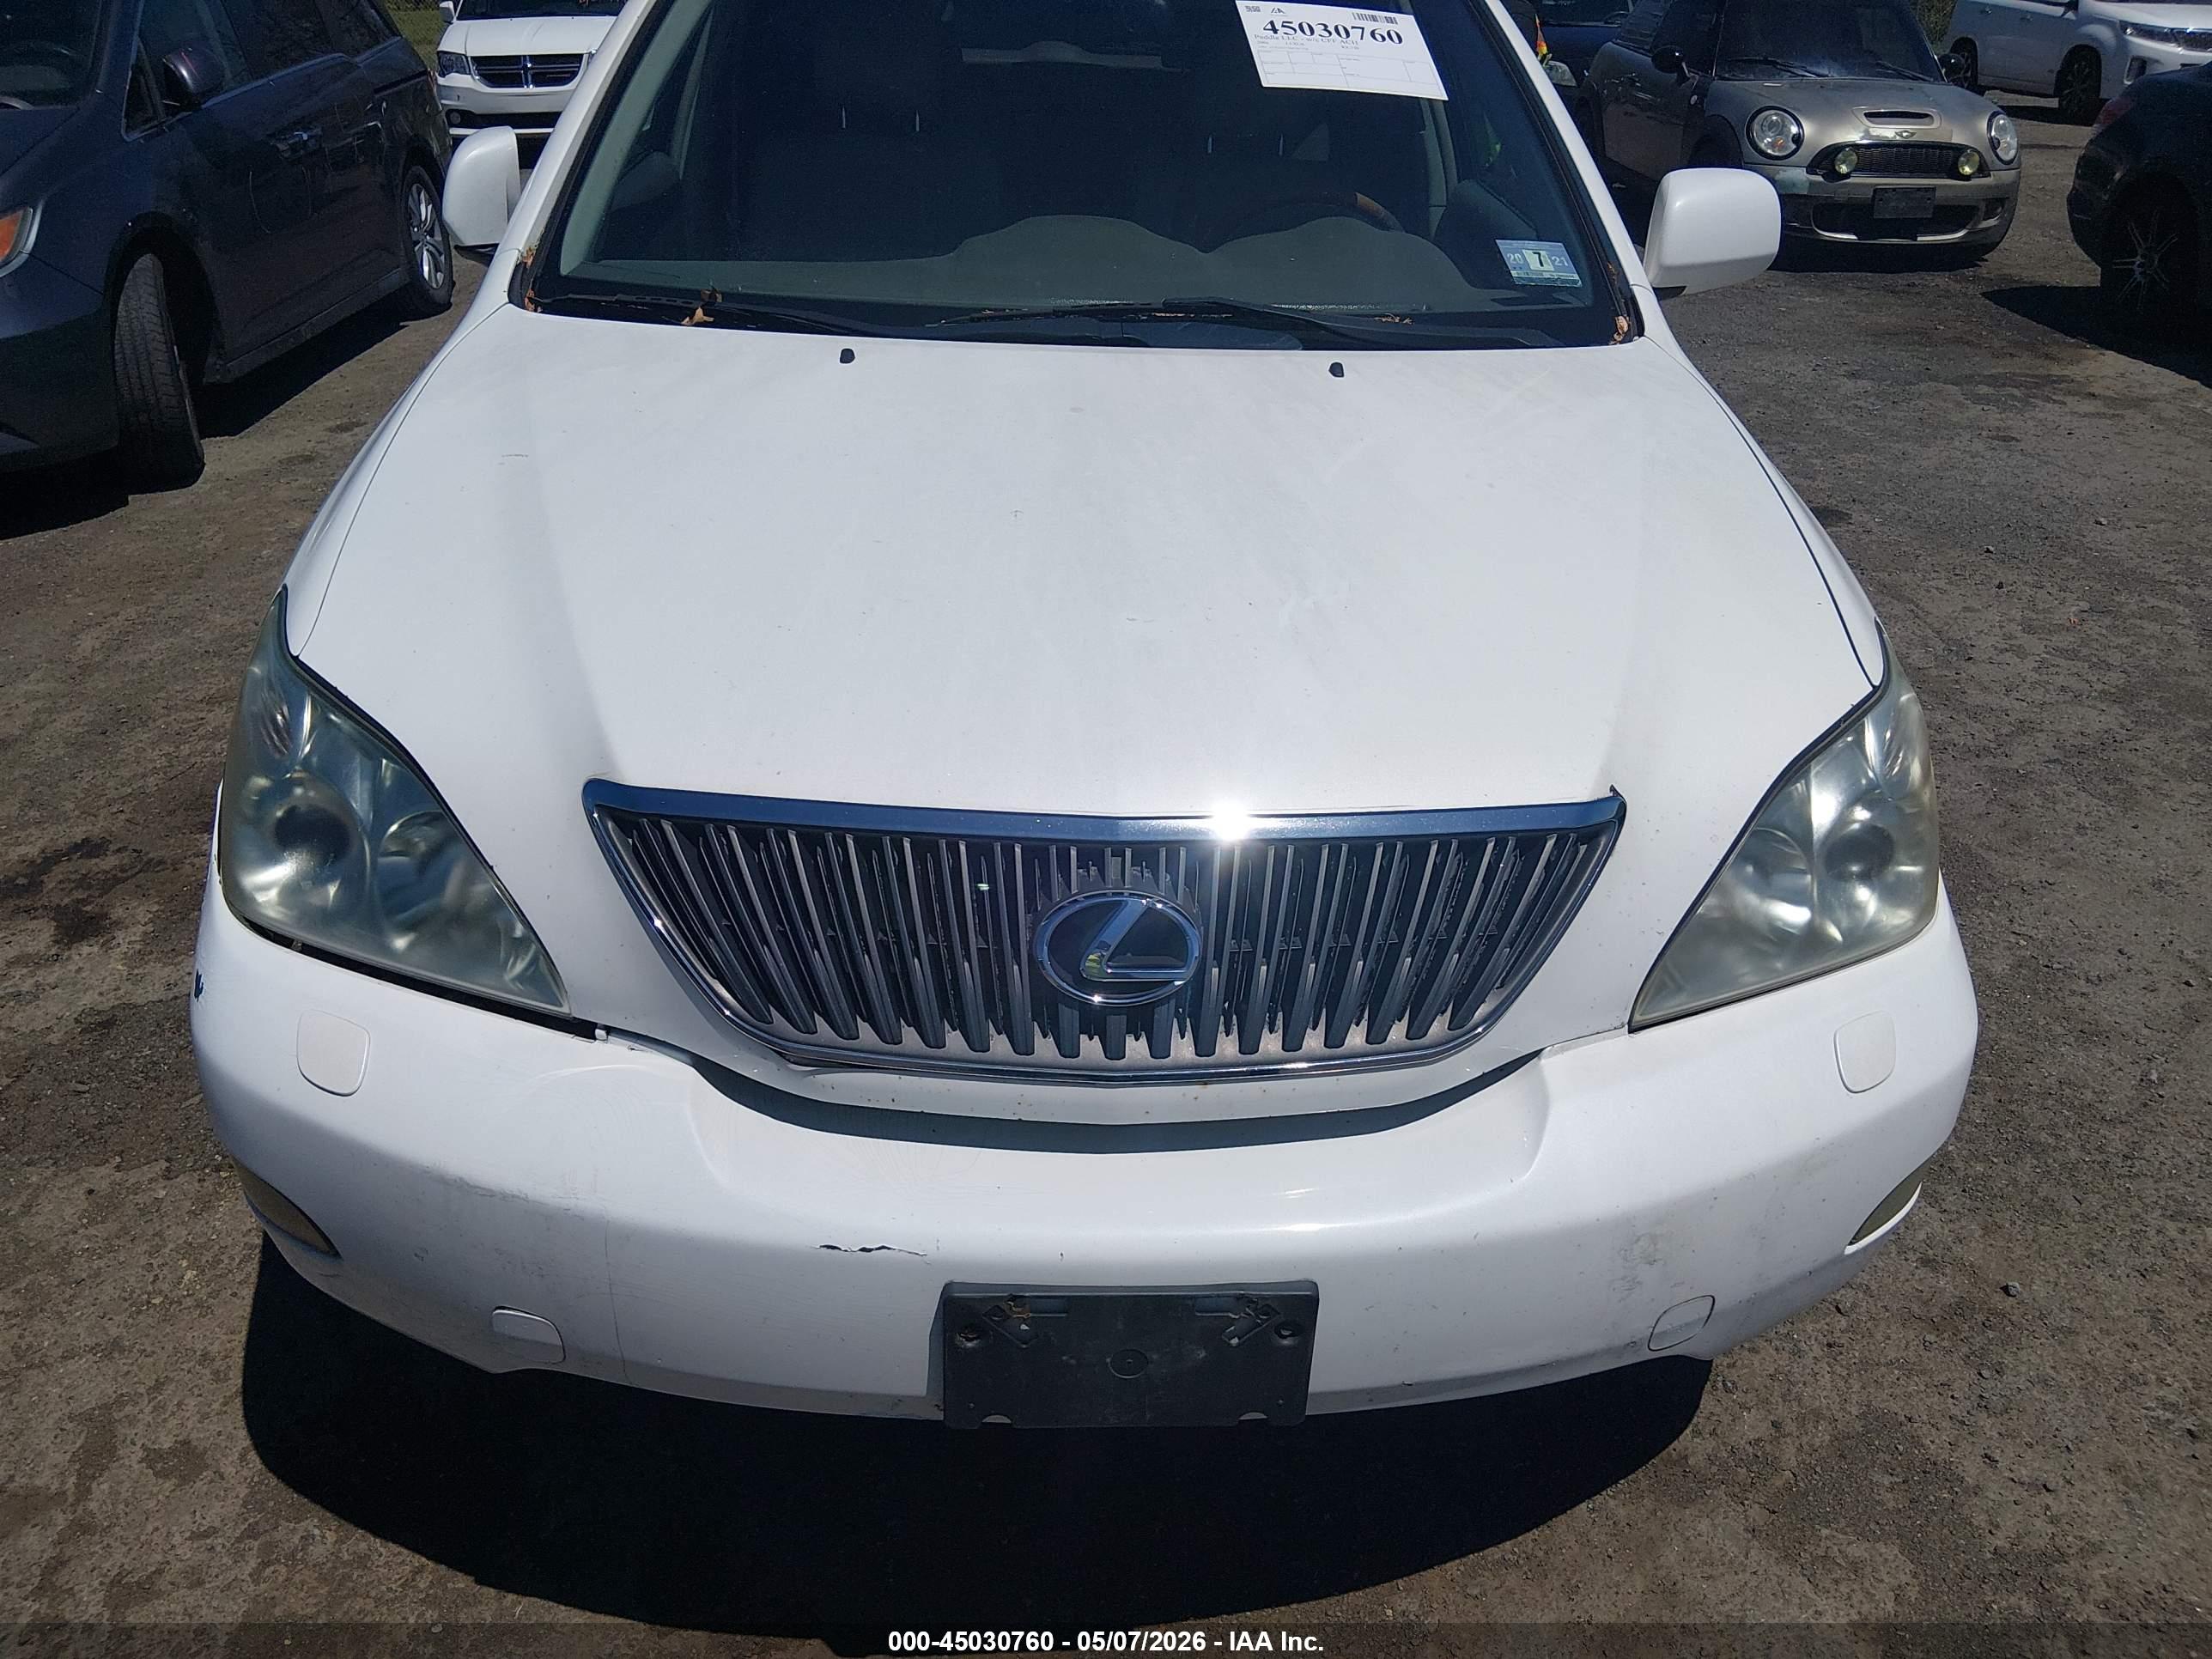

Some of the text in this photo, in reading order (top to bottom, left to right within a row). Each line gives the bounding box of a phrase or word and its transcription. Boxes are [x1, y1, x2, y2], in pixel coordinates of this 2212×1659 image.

[1262, 20, 1403, 45] 45030760
[1507, 251, 1568, 267] 20 7 21
